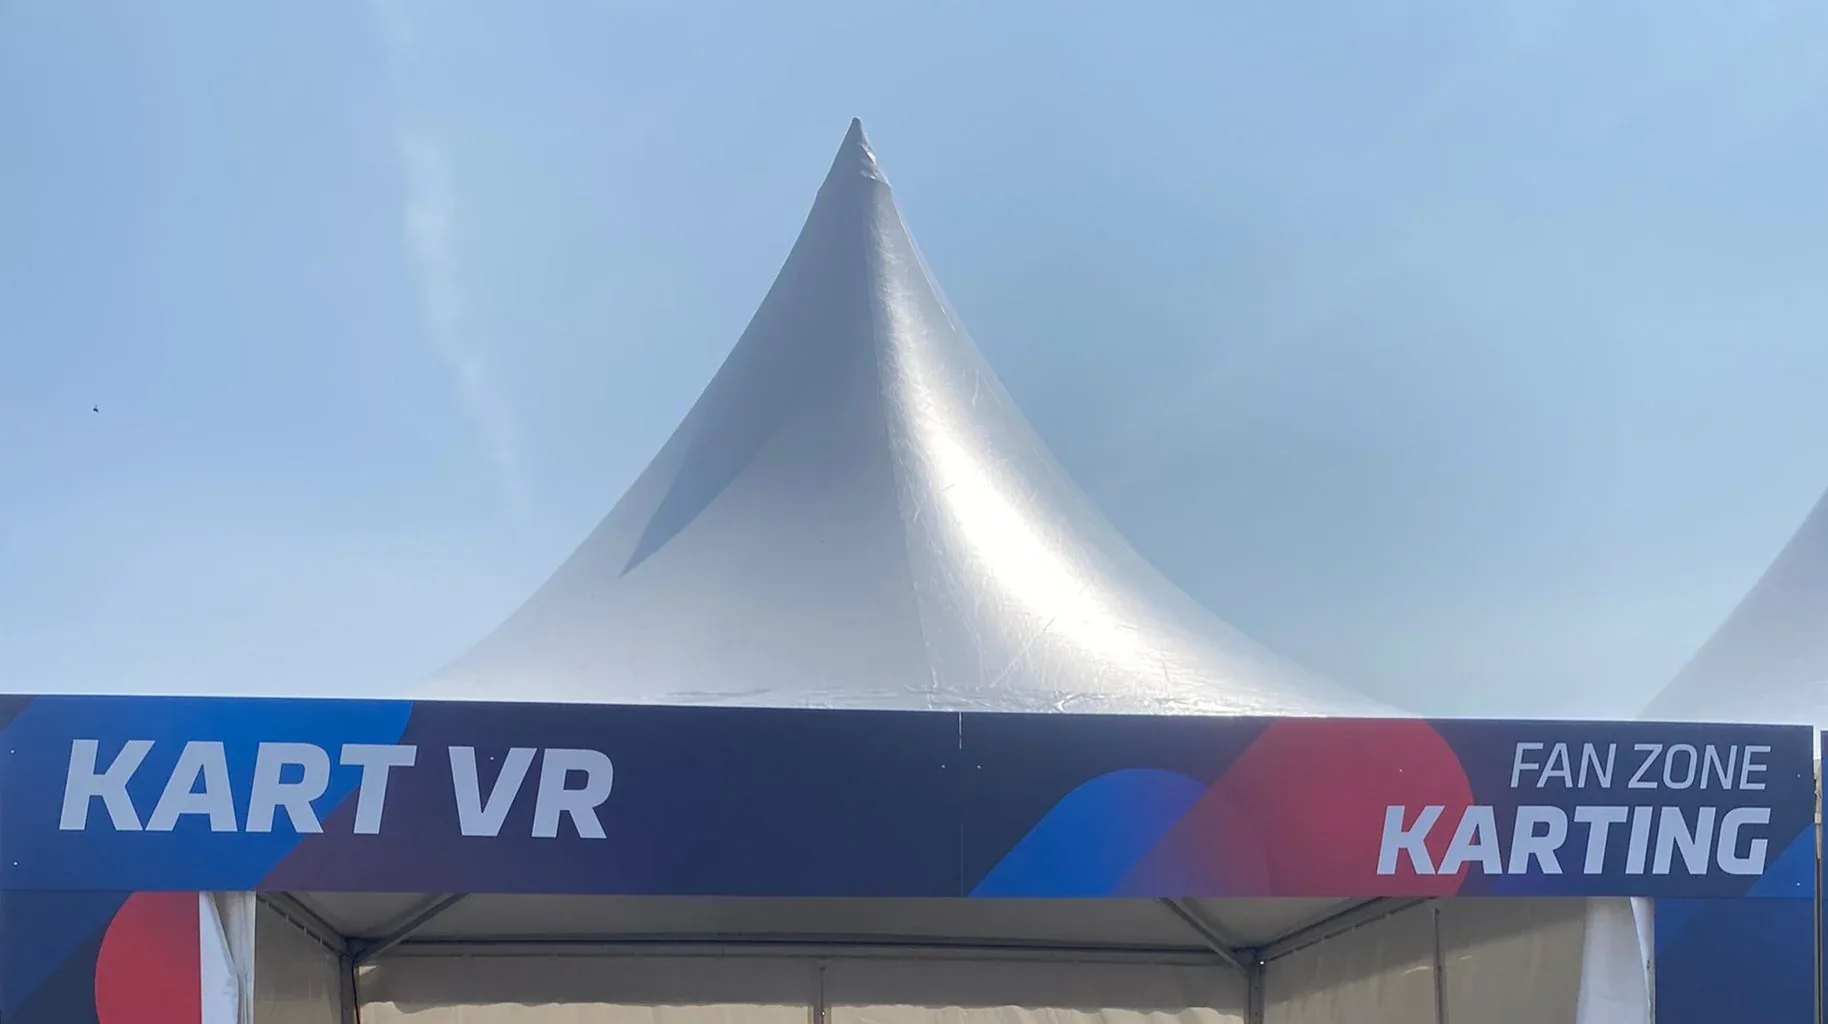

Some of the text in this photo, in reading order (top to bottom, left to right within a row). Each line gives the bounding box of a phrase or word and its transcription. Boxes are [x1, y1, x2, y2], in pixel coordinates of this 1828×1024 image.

[58, 739, 614, 838] KART VR
[1510, 742, 1772, 791] FAN ZONE
[1376, 805, 1772, 876] KARTING
